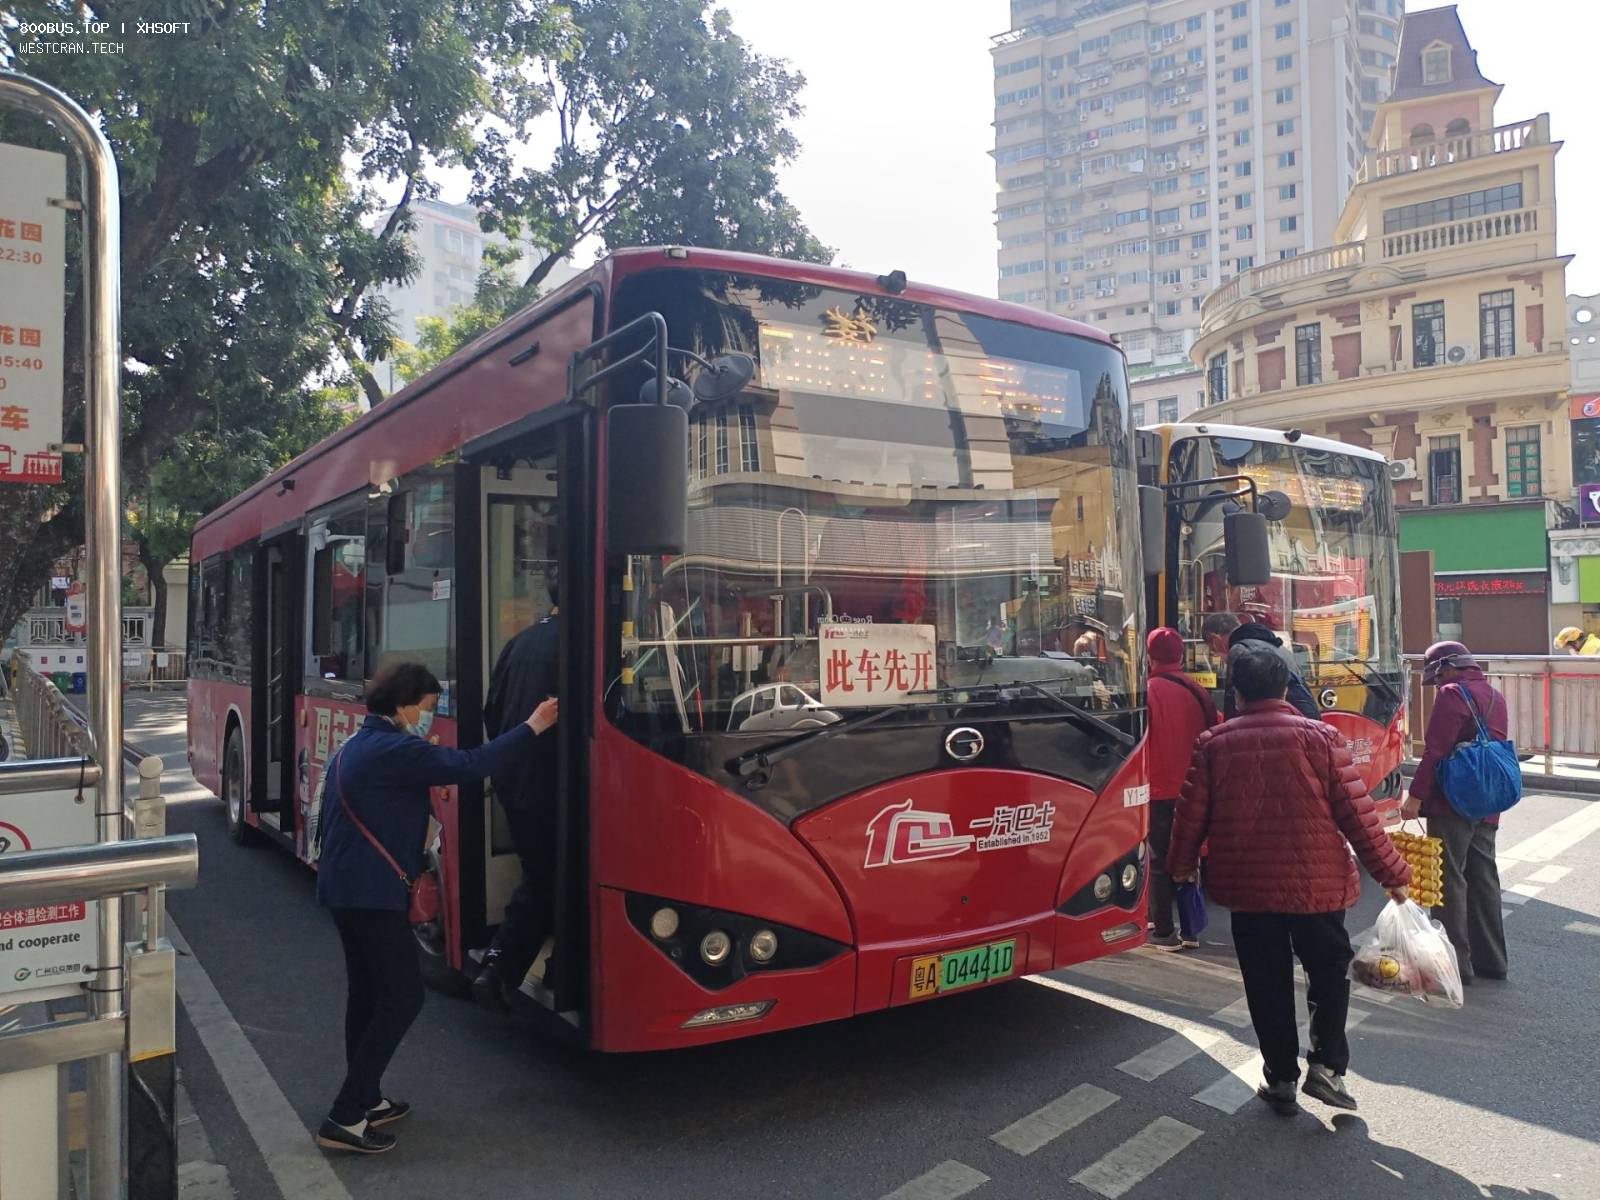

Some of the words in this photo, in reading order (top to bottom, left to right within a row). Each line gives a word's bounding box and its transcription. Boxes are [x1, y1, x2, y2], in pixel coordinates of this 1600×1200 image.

[0, 356, 43, 370] 5:40
[0, 405, 30, 431] 车
[825, 648, 934, 694] 此车先开
[970, 801, 1055, 837] 一汽巴士
[978, 836, 1021, 850] Established
[1031, 832, 1049, 843] 1952
[0, 904, 80, 927] 合体温检测工作
[18, 933, 81, 949] cooperate
[913, 962, 937, 992] 粤A
[945, 944, 1014, 985] 04441D
